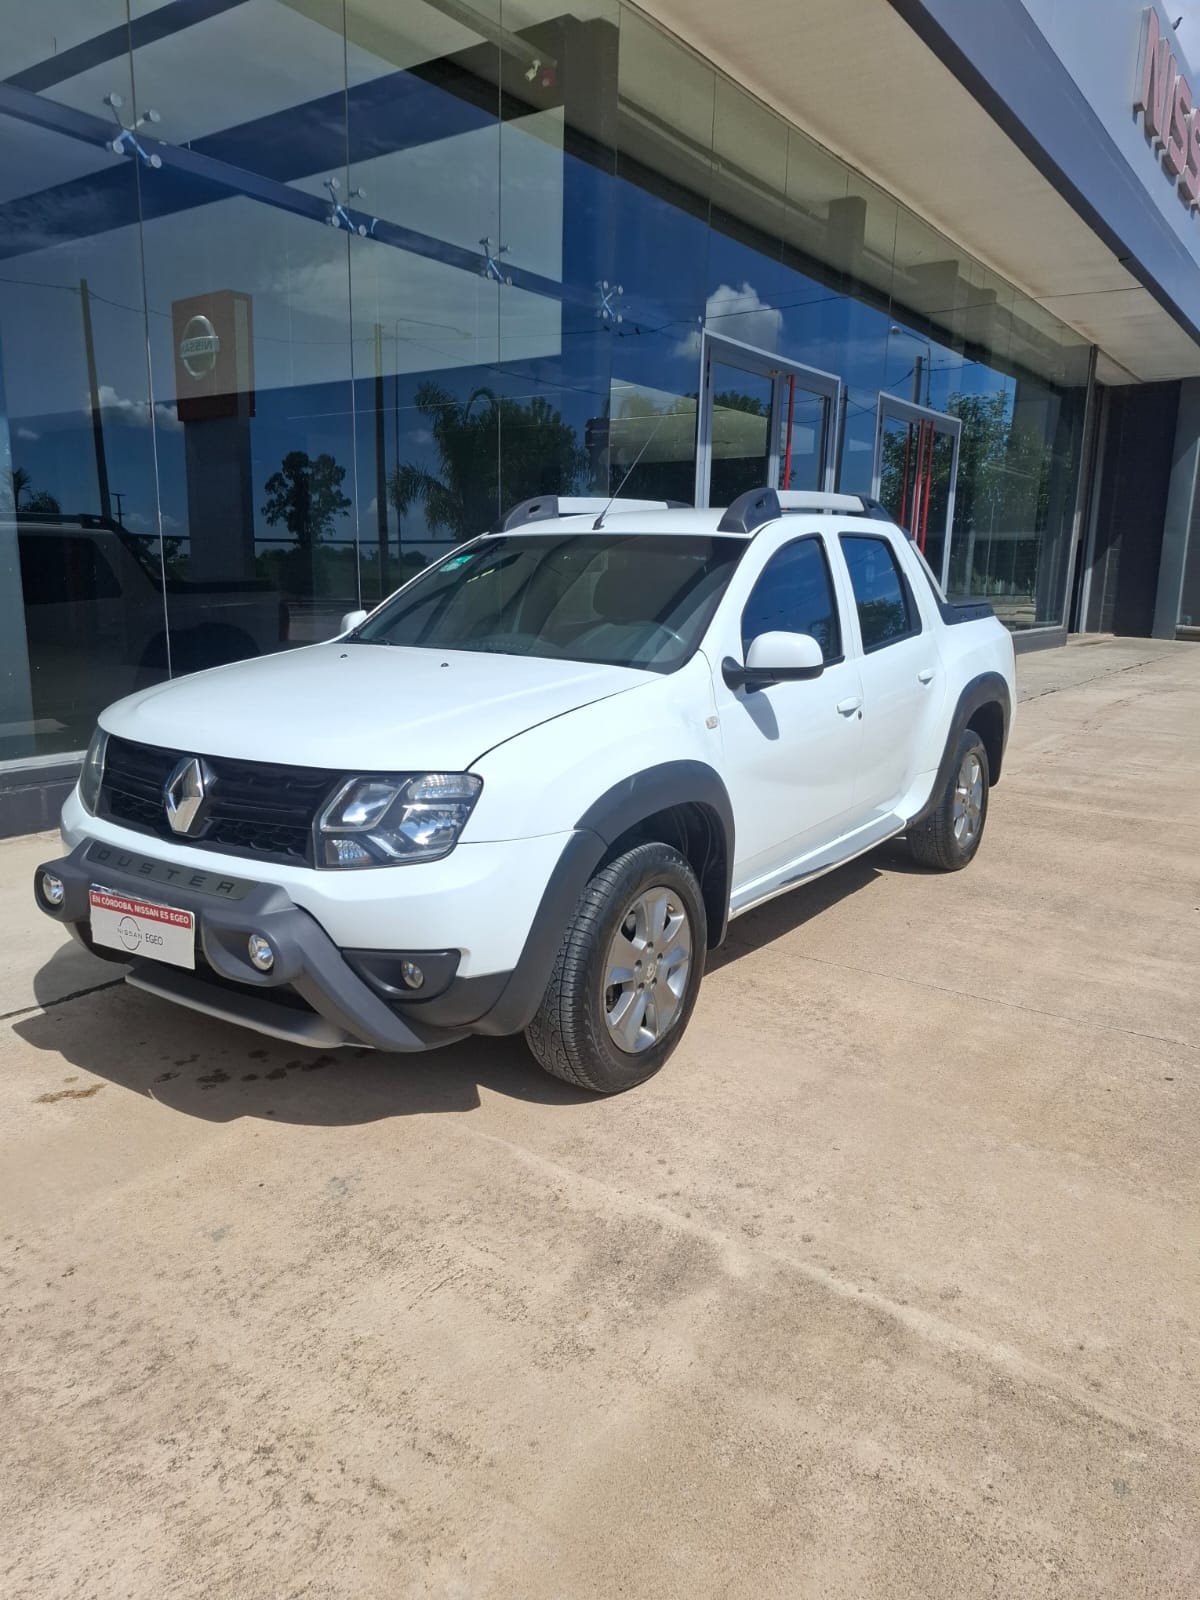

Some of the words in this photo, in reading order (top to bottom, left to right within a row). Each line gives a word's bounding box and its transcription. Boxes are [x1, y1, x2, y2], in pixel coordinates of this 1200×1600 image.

[97, 850, 235, 894] DUSTER
[92, 895, 100, 905] EN
[134, 905, 159, 919] NISSAN
[160, 910, 169, 920] ES
[170, 913, 189, 925] EGEO
[116, 927, 143, 940] NISSAN
[145, 932, 164, 946] EGEO
